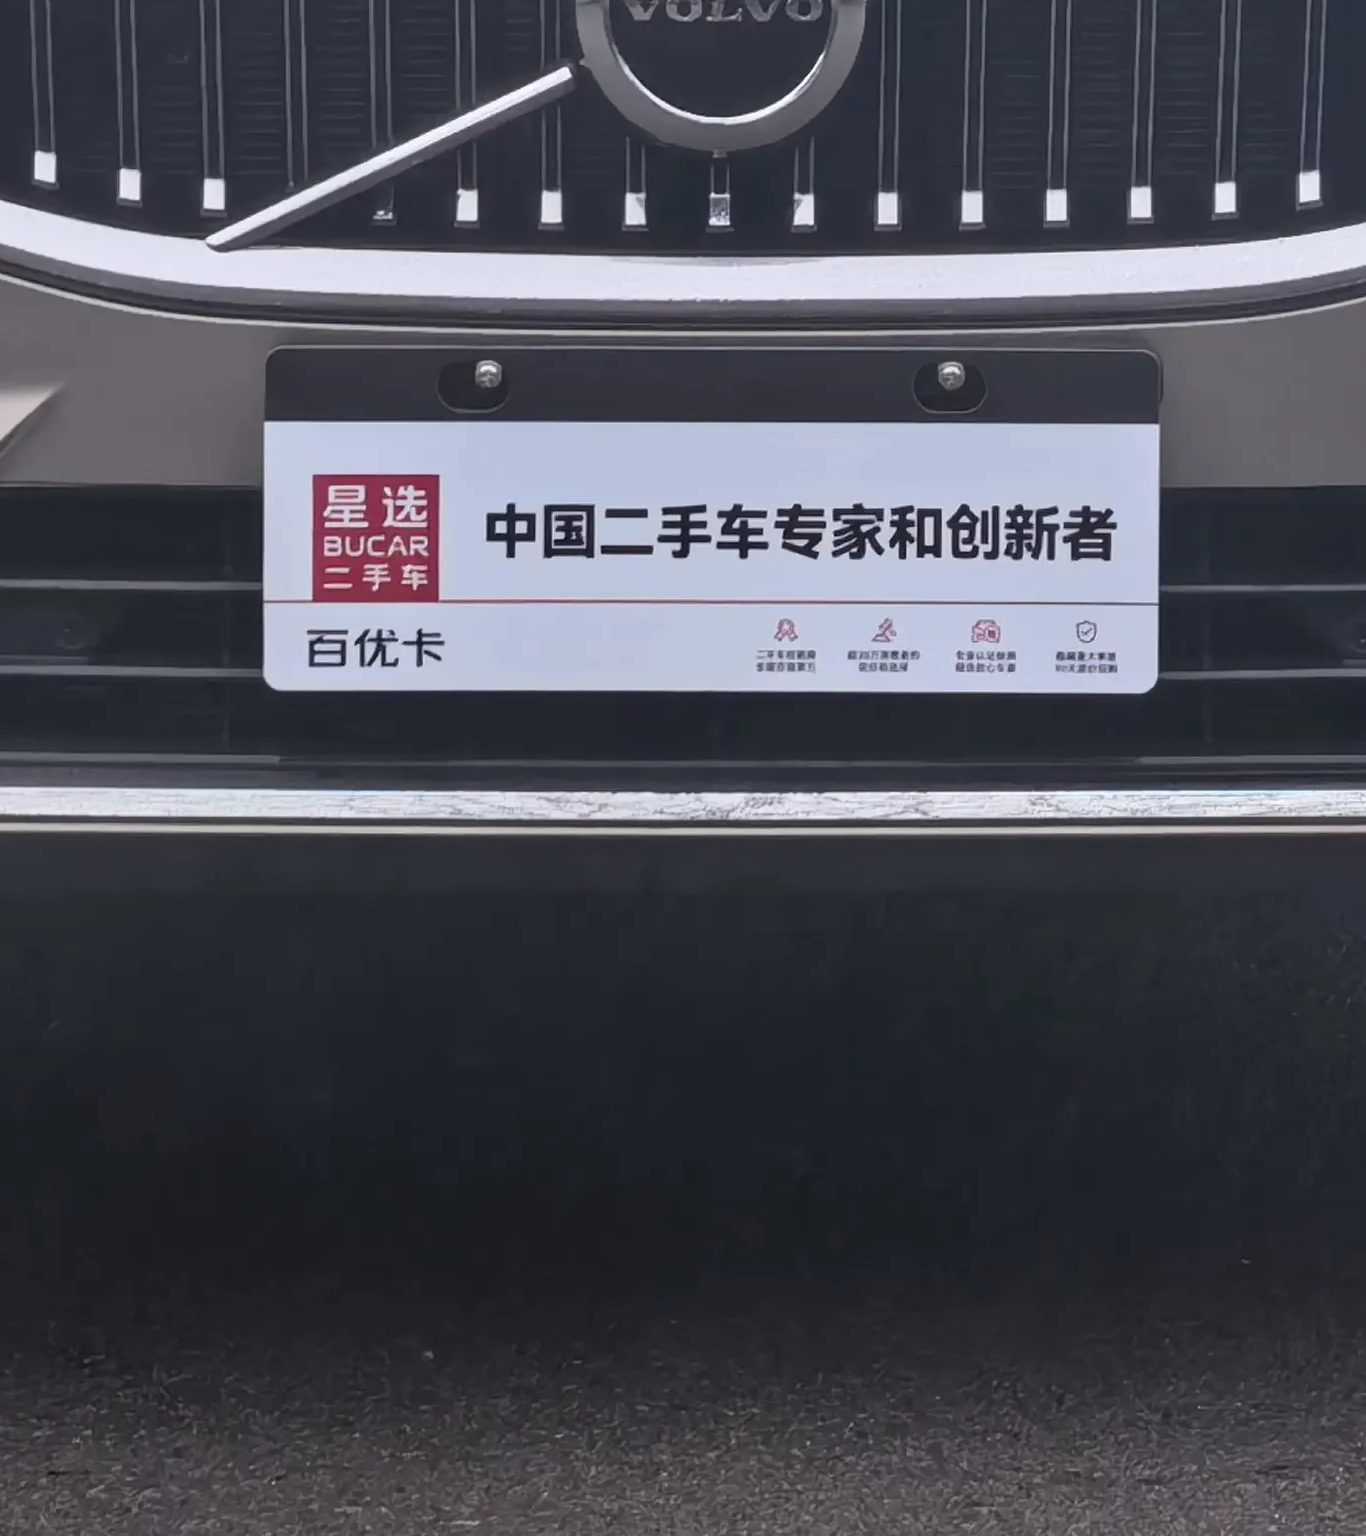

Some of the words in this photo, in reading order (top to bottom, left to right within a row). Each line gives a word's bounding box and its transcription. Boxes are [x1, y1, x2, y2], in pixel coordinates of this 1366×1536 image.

[323, 485, 428, 528] 星选
[323, 535, 429, 557] BUCAR
[485, 503, 1118, 561] 中国二手车专家和创新者
[323, 564, 428, 591] 二手车
[306, 628, 445, 668] 百优卡
